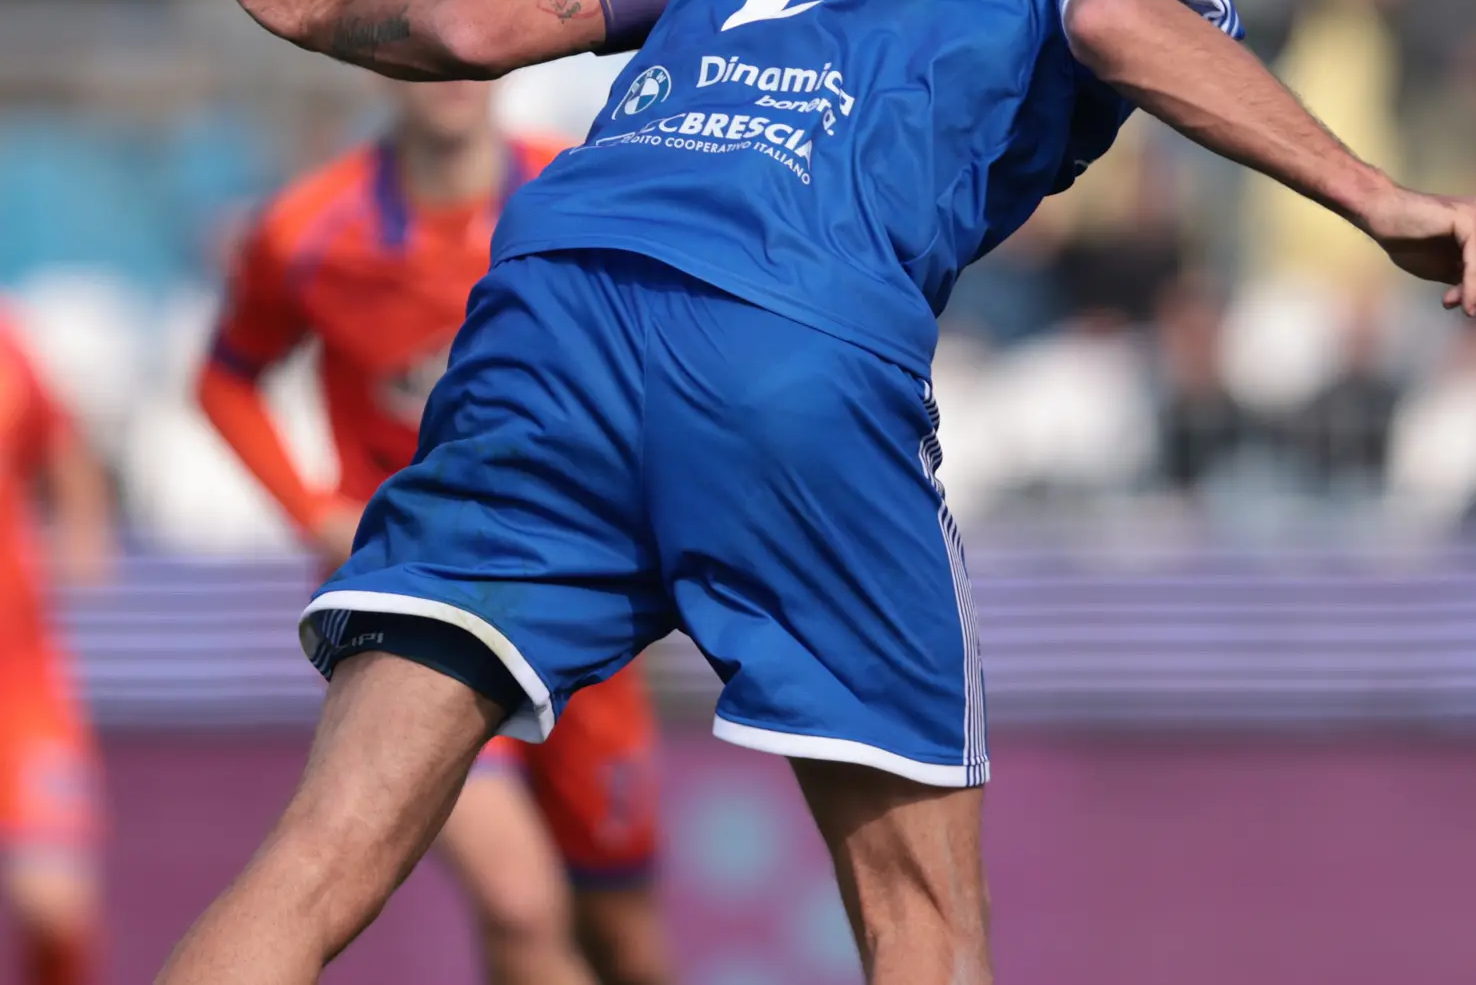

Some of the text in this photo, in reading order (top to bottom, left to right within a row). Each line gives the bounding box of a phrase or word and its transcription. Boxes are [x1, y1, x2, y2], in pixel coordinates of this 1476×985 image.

[696, 55, 856, 117] Dinamica
[664, 136, 752, 154] COOPERATIVO
[753, 140, 812, 185] ITALIANO
